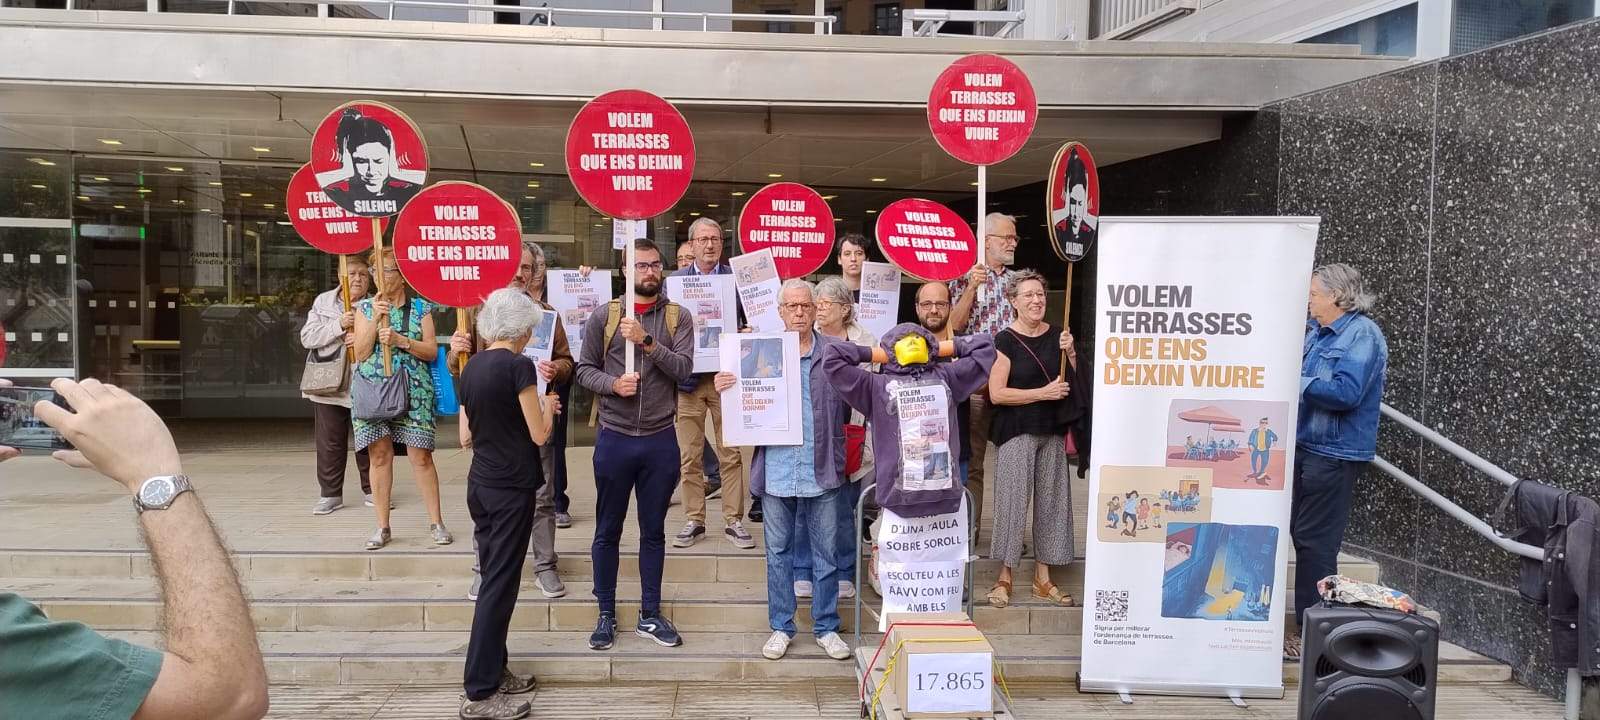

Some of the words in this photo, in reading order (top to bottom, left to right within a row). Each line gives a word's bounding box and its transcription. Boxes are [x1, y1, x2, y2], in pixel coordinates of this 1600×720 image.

[964, 73, 1003, 87] VOLEM
[950, 91, 1016, 105] TERRASSES
[608, 112, 653, 128] VOLEM
[939, 108, 962, 123] QUE
[964, 109, 986, 123] ENS
[988, 110, 1026, 123] DEIXIN
[592, 133, 669, 149] TERRASSES
[965, 127, 999, 141] VIURE
[580, 154, 607, 171] QUE
[610, 155, 636, 170] ENS
[638, 155, 682, 170] DEIXIN
[612, 175, 653, 191] VIURE
[354, 200, 397, 213] SILENCI
[434, 205, 480, 220] VOLEM
[771, 199, 805, 212] VOLEM
[298, 208, 321, 220] QUE
[322, 206, 344, 218] ENS
[904, 211, 941, 223] VOLEM
[325, 222, 359, 235] VIURE
[760, 215, 816, 228] TERRASSES
[419, 226, 496, 240] TERRASSES
[749, 230, 770, 243] QUE
[771, 231, 790, 242] ENS
[792, 232, 825, 244] DEIXIN
[895, 223, 956, 237] TERRASSES
[888, 236, 911, 247] QUE
[911, 238, 932, 249] ENS
[933, 239, 969, 251] DEIXIN
[407, 246, 435, 262] QUE
[437, 246, 463, 261] ENS
[465, 246, 509, 260] DEIXIN
[772, 246, 802, 258] VIURE
[915, 251, 949, 263] VIURE
[440, 266, 480, 280] VIURE
[1107, 284, 1193, 308] VOLEM
[1106, 311, 1253, 336] TERRASSES
[1104, 337, 1154, 366] QUE
[1157, 338, 1208, 361] ENS
[1103, 363, 1185, 386] DEIXIN
[1189, 365, 1266, 388] VIURE
[899, 389, 921, 397] VOLEM
[900, 394, 936, 404] TERRASSES
[891, 524, 924, 534] D'UNA
[886, 541, 921, 551] SOBRE
[923, 536, 962, 549] SOROLL
[887, 571, 934, 580] ESCOLTEU
[937, 571, 944, 579] A
[946, 569, 960, 578] LES
[889, 586, 919, 597] AAVV
[921, 587, 944, 597] COM
[947, 586, 960, 595] FEU
[906, 603, 928, 612] AMB
[931, 602, 946, 611] ELS
[914, 671, 985, 691] 17.865
